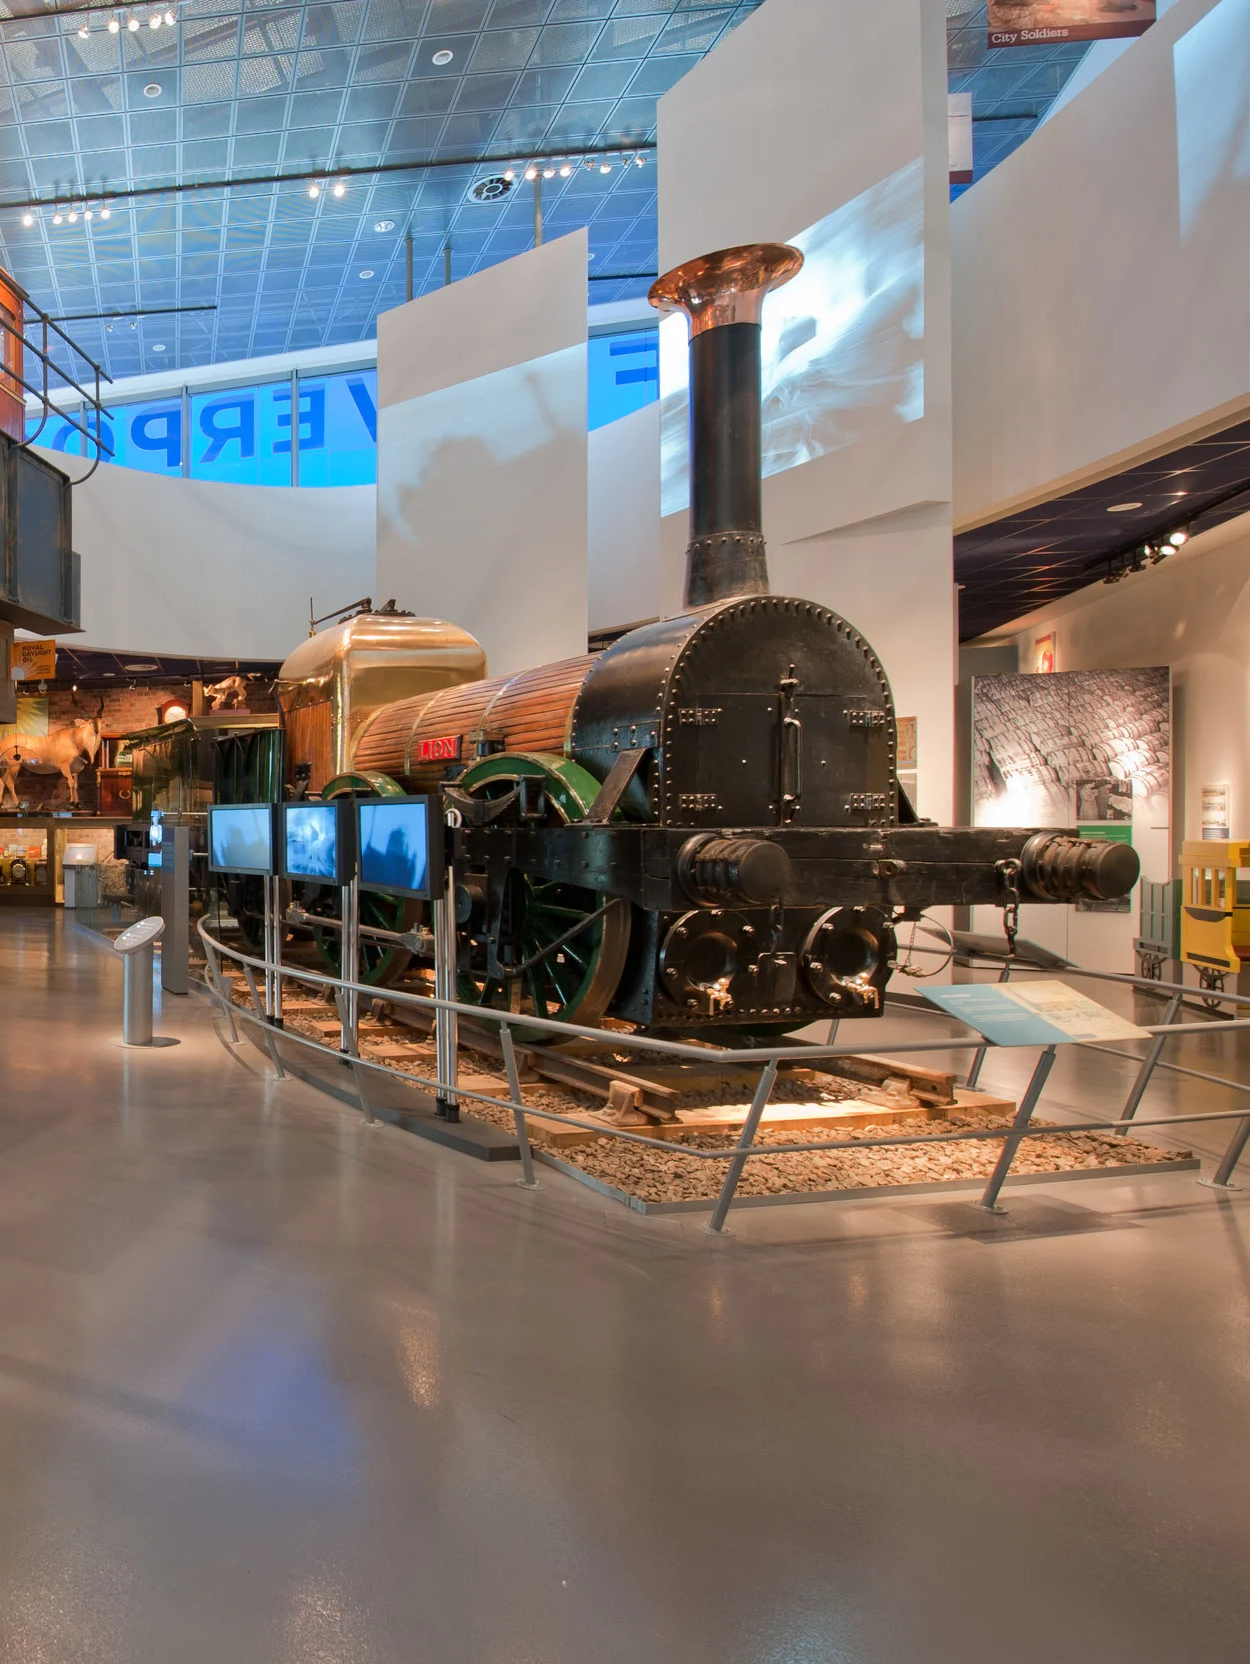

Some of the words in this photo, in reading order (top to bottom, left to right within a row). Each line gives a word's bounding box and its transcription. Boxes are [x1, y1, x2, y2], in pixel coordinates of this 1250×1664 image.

[991, 33, 1018, 44] City
[1021, 28, 1069, 40] Soldiers
[417, 738, 456, 762] LION
